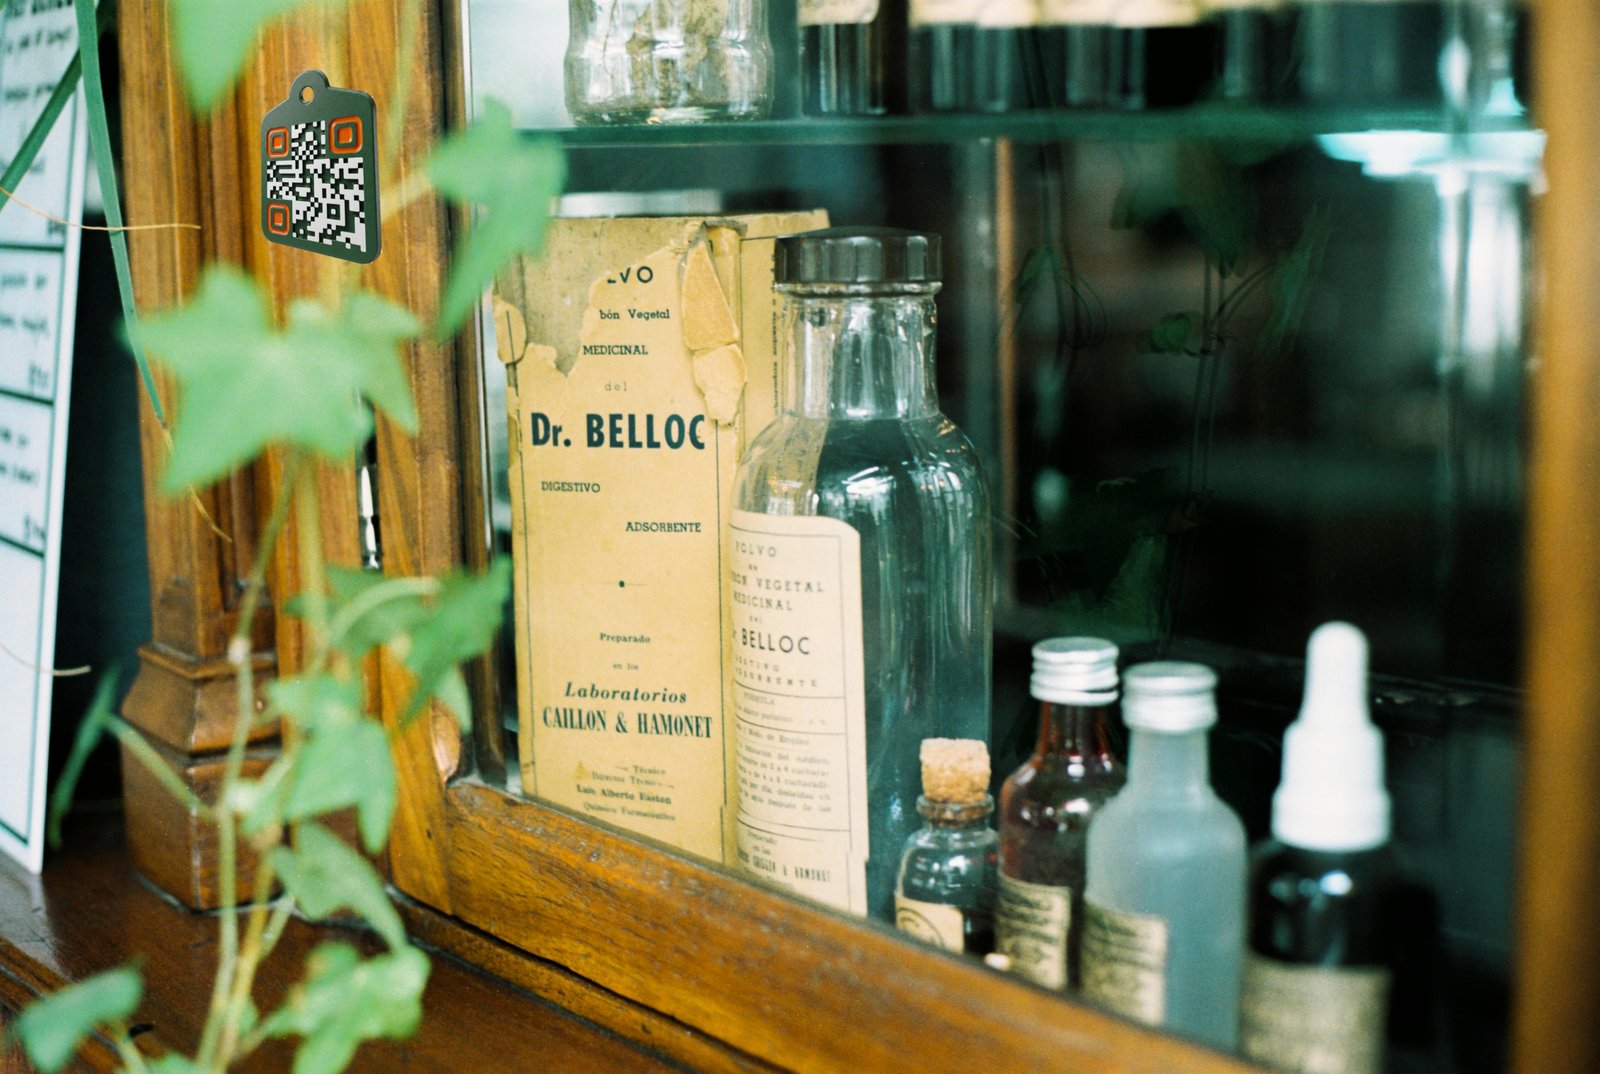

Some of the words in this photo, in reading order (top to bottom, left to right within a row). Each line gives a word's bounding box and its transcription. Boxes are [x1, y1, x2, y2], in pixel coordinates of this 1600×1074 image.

[607, 265, 653, 284] VO
[628, 308, 671, 322] Vegetal
[583, 345, 649, 356] MEDICINAL
[604, 381, 628, 392] del
[531, 412, 572, 447] Dr.
[586, 413, 706, 450] BELLOC
[541, 481, 601, 493] DIGESTIVO
[625, 522, 702, 533] ADSORBENTE
[756, 577, 824, 593] VEGETAL
[599, 632, 651, 644] Preparado
[741, 627, 811, 655] BELLOC
[564, 681, 688, 705] Laboratorios
[542, 705, 607, 732] CAILLON
[615, 711, 629, 734] &
[637, 712, 713, 739] HAMONET
